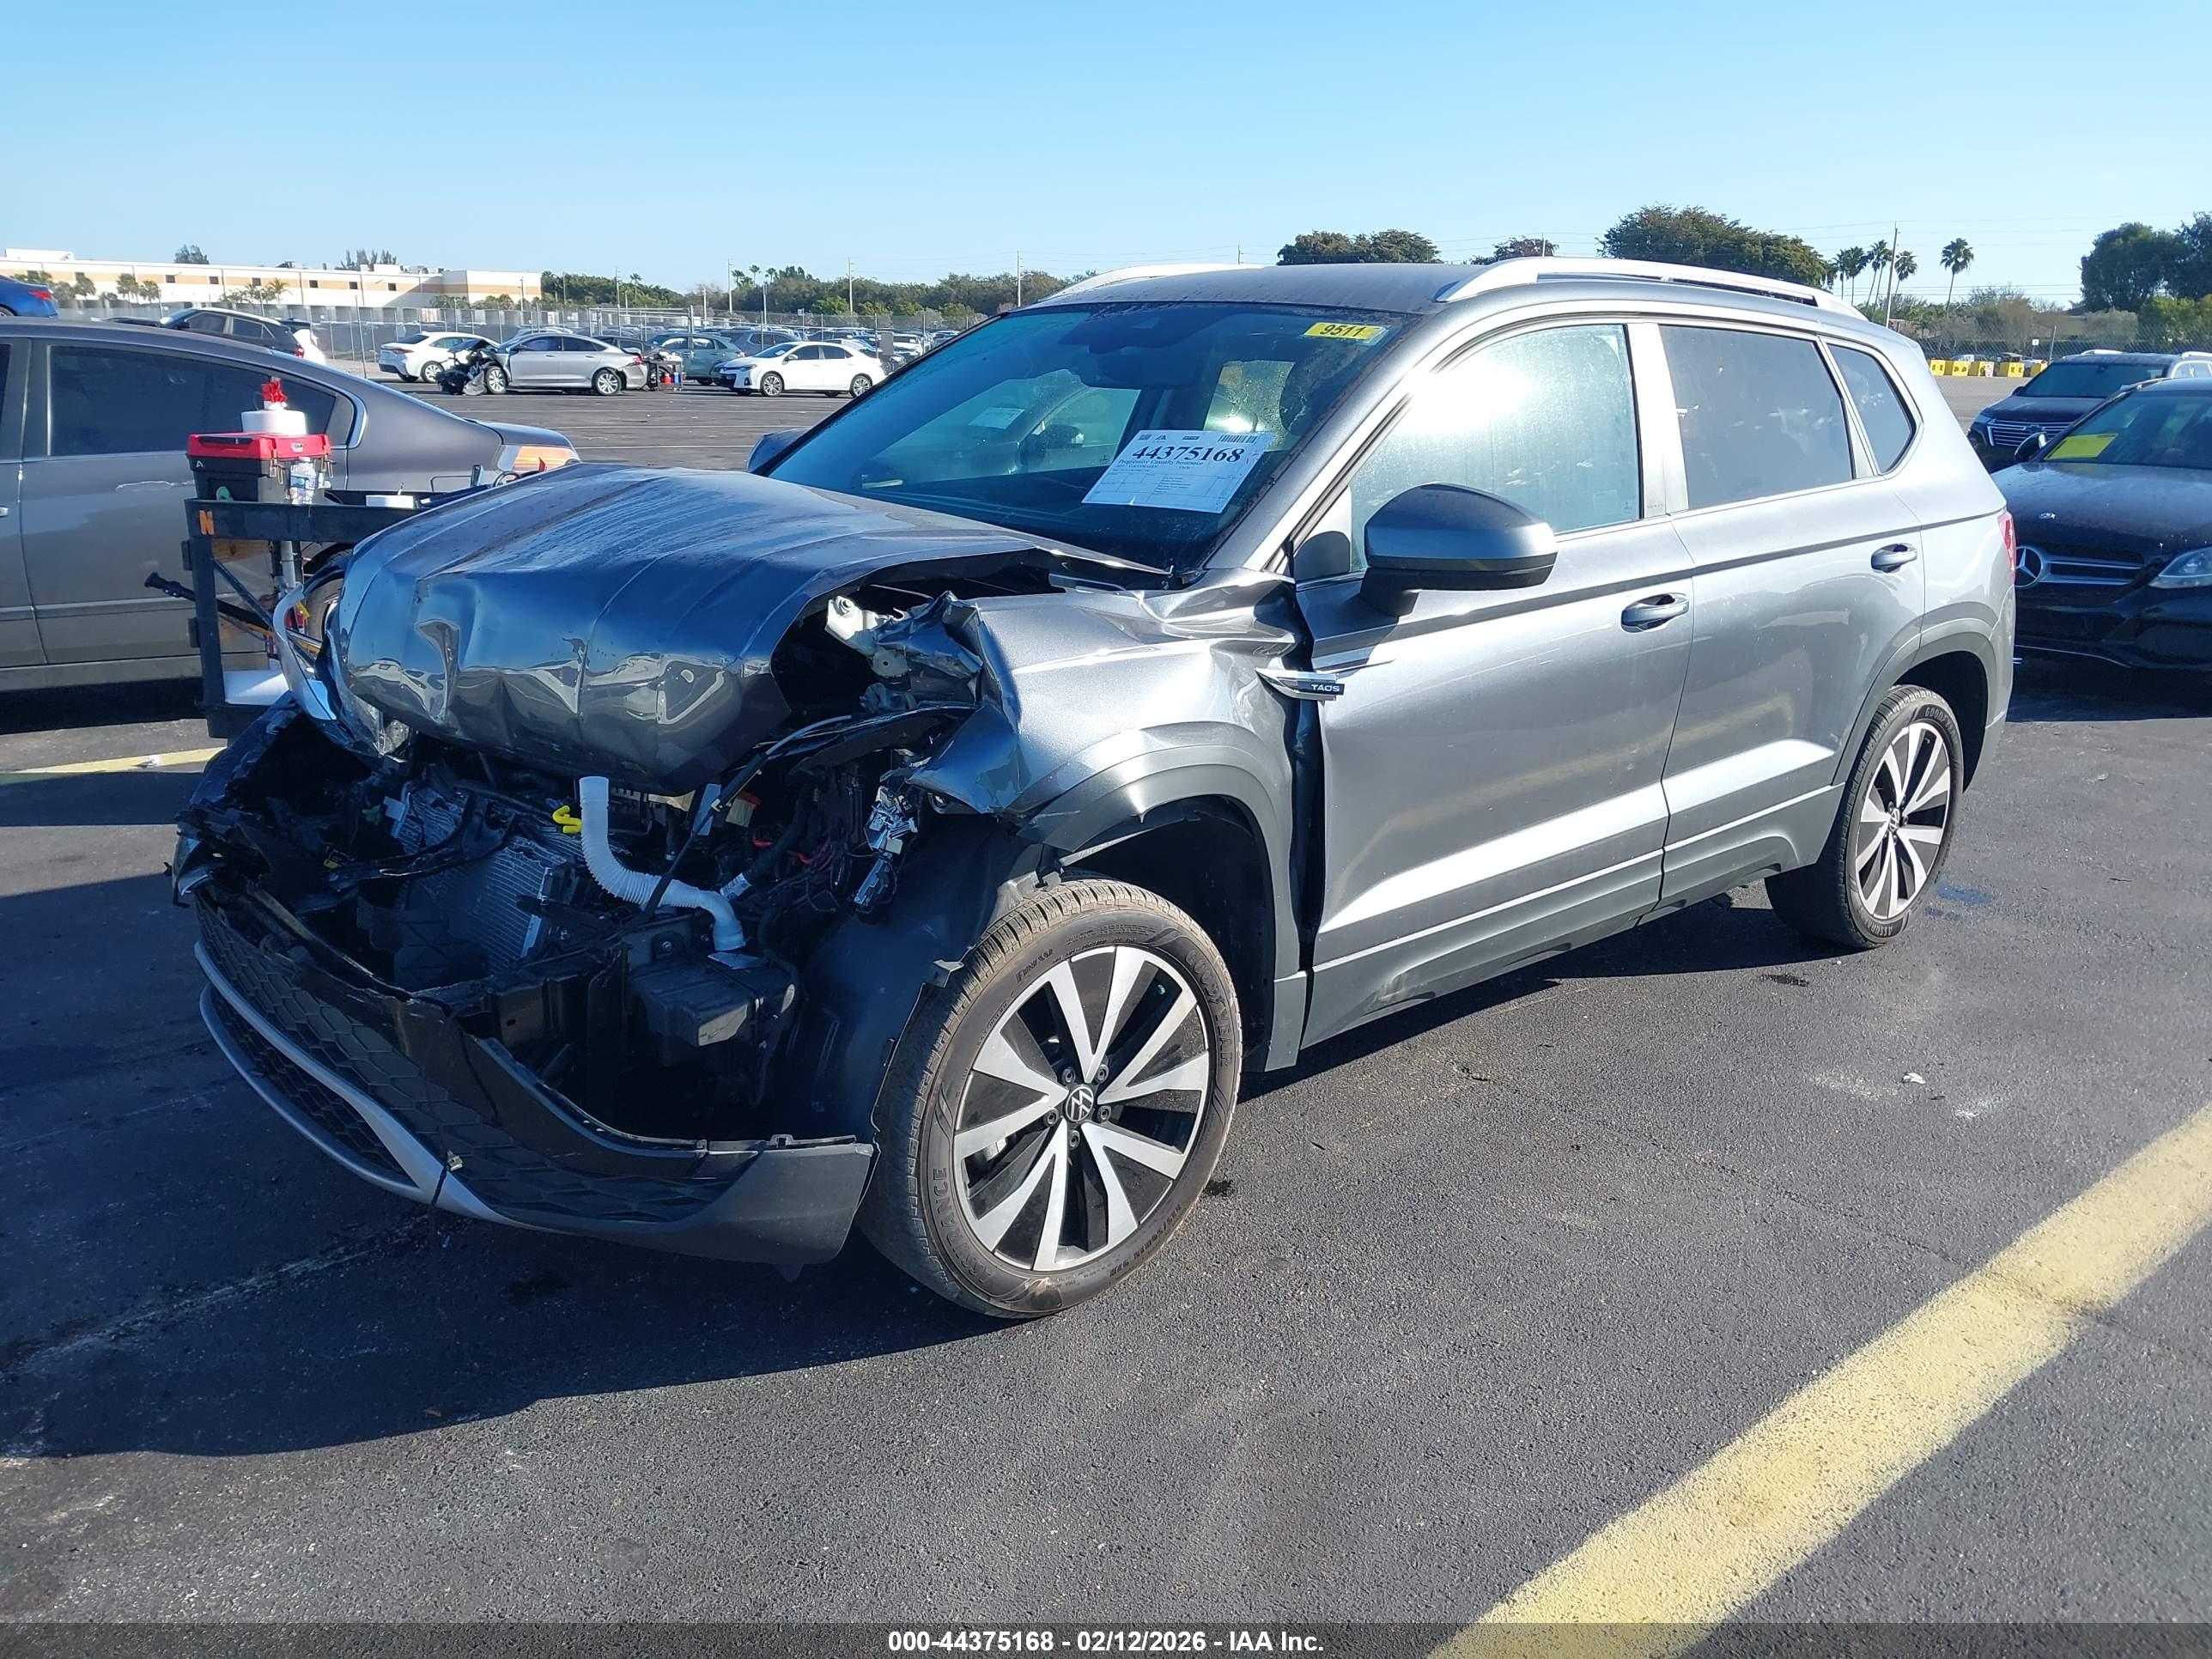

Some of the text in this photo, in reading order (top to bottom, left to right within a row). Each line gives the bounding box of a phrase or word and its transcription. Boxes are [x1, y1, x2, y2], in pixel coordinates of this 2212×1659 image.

[1320, 325, 1366, 337] 9511
[1132, 446, 1244, 462] 44375168
[199, 510, 214, 535] N
[1311, 684, 1340, 692] TAOS
[1185, 950, 1231, 1067] GOODYEAR
